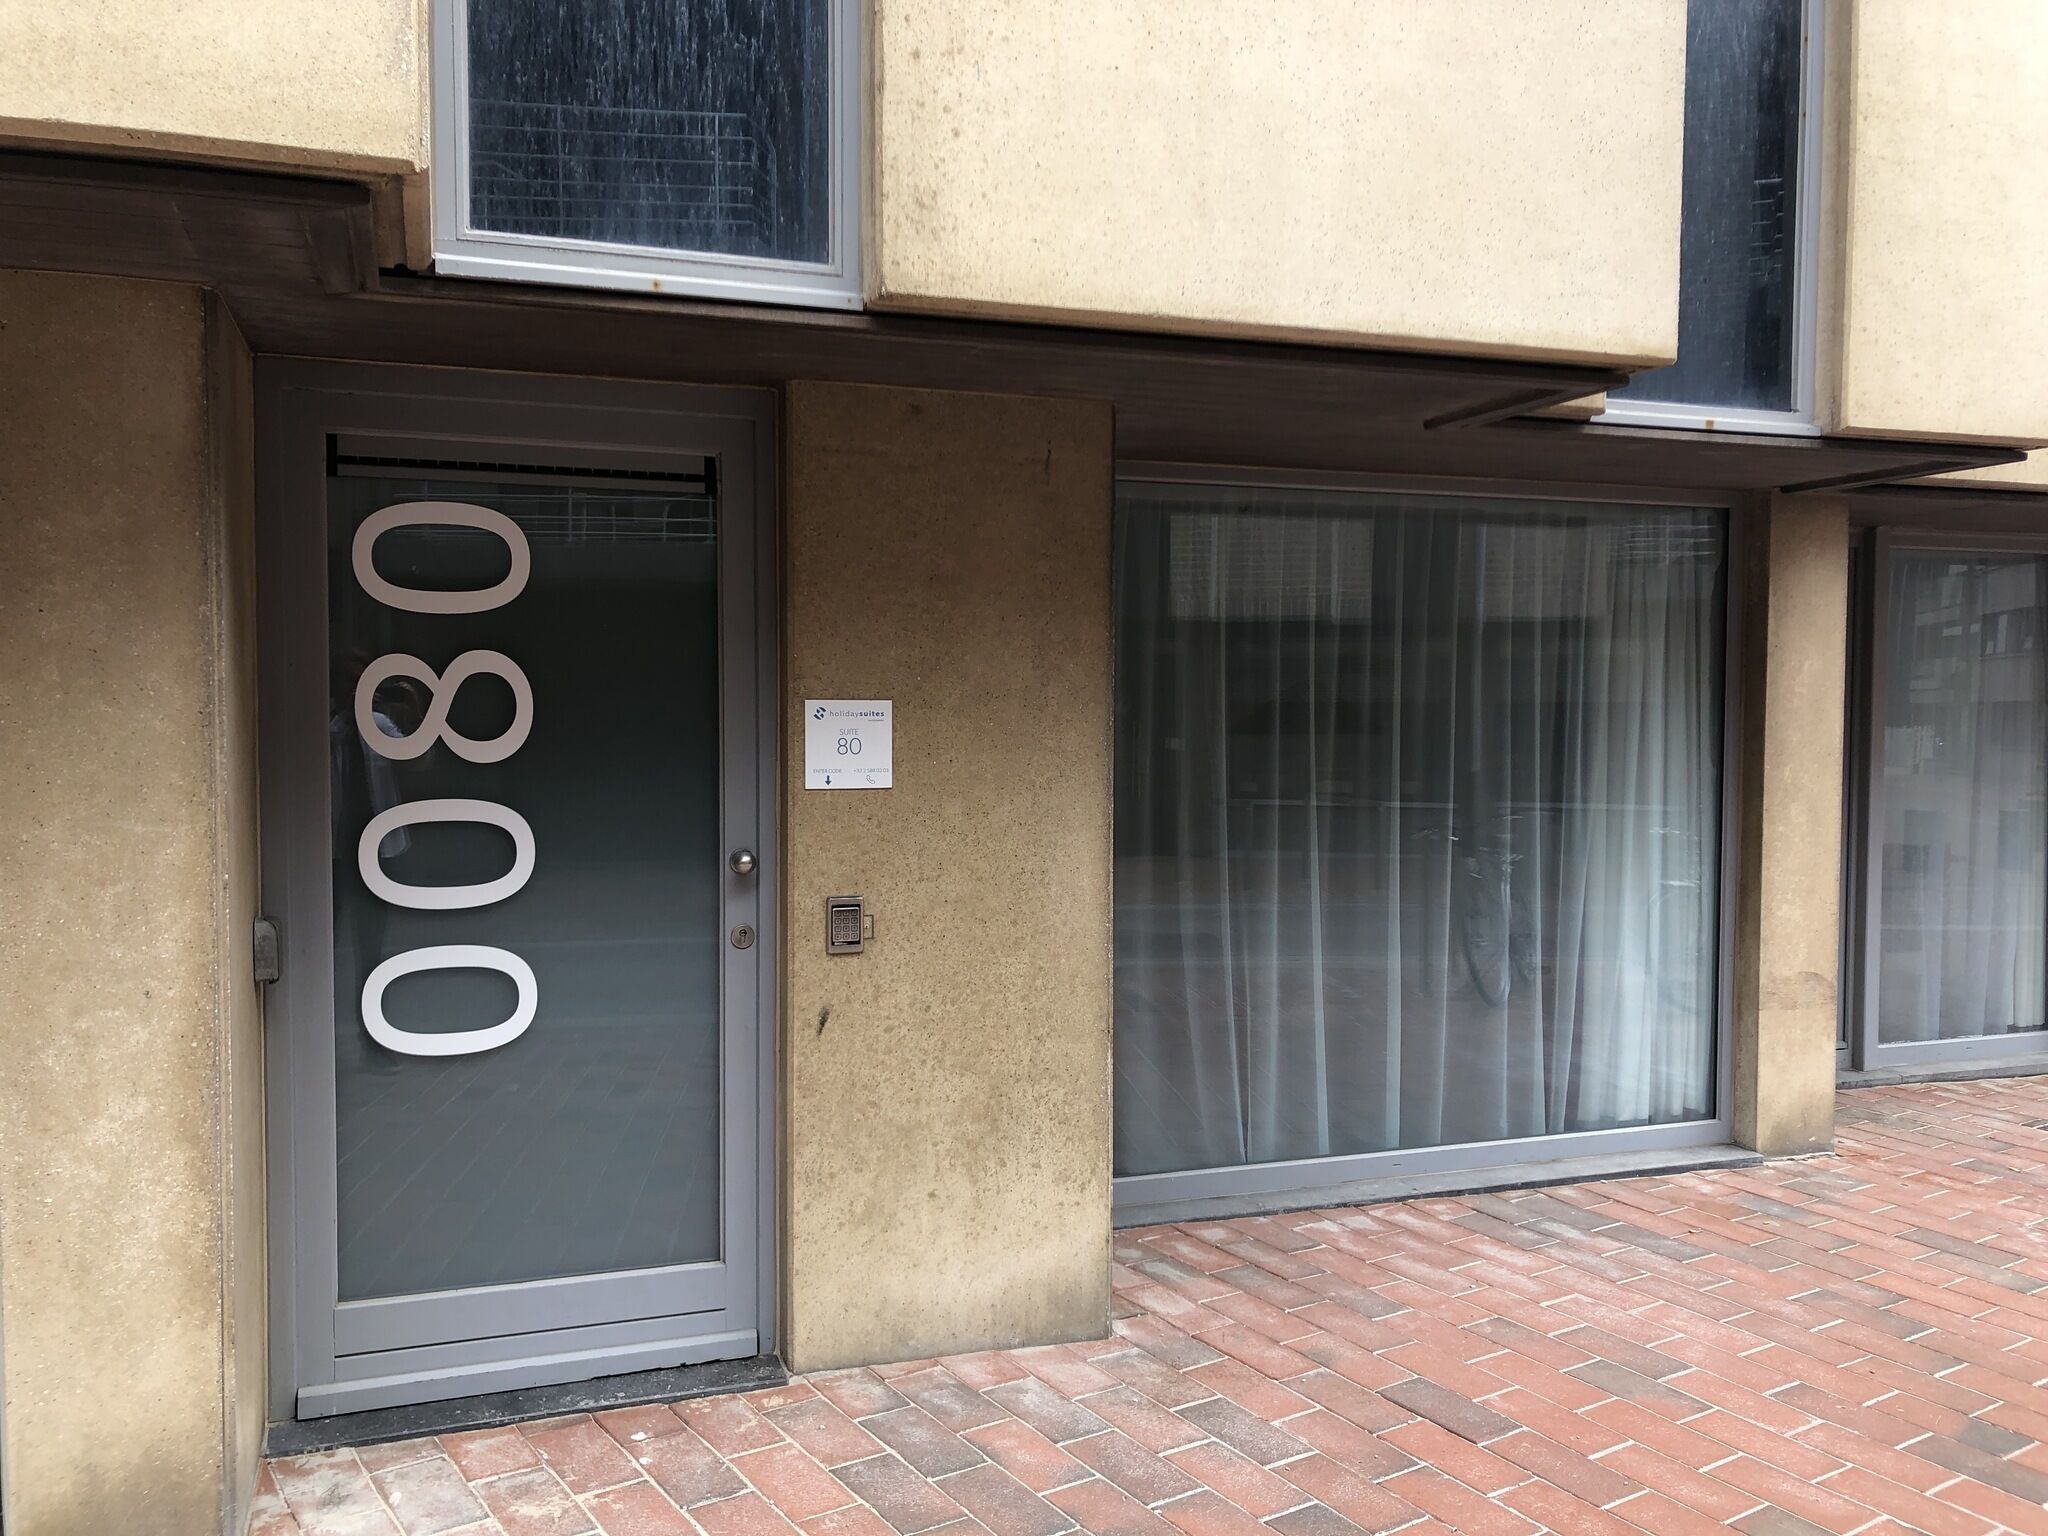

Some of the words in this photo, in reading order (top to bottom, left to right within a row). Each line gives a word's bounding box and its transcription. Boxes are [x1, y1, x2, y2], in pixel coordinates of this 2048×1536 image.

[829, 710, 885, 719] holidaysuites
[839, 728, 859, 736] SUITE
[837, 737, 862, 755] 80
[351, 500, 539, 1057] 0080
